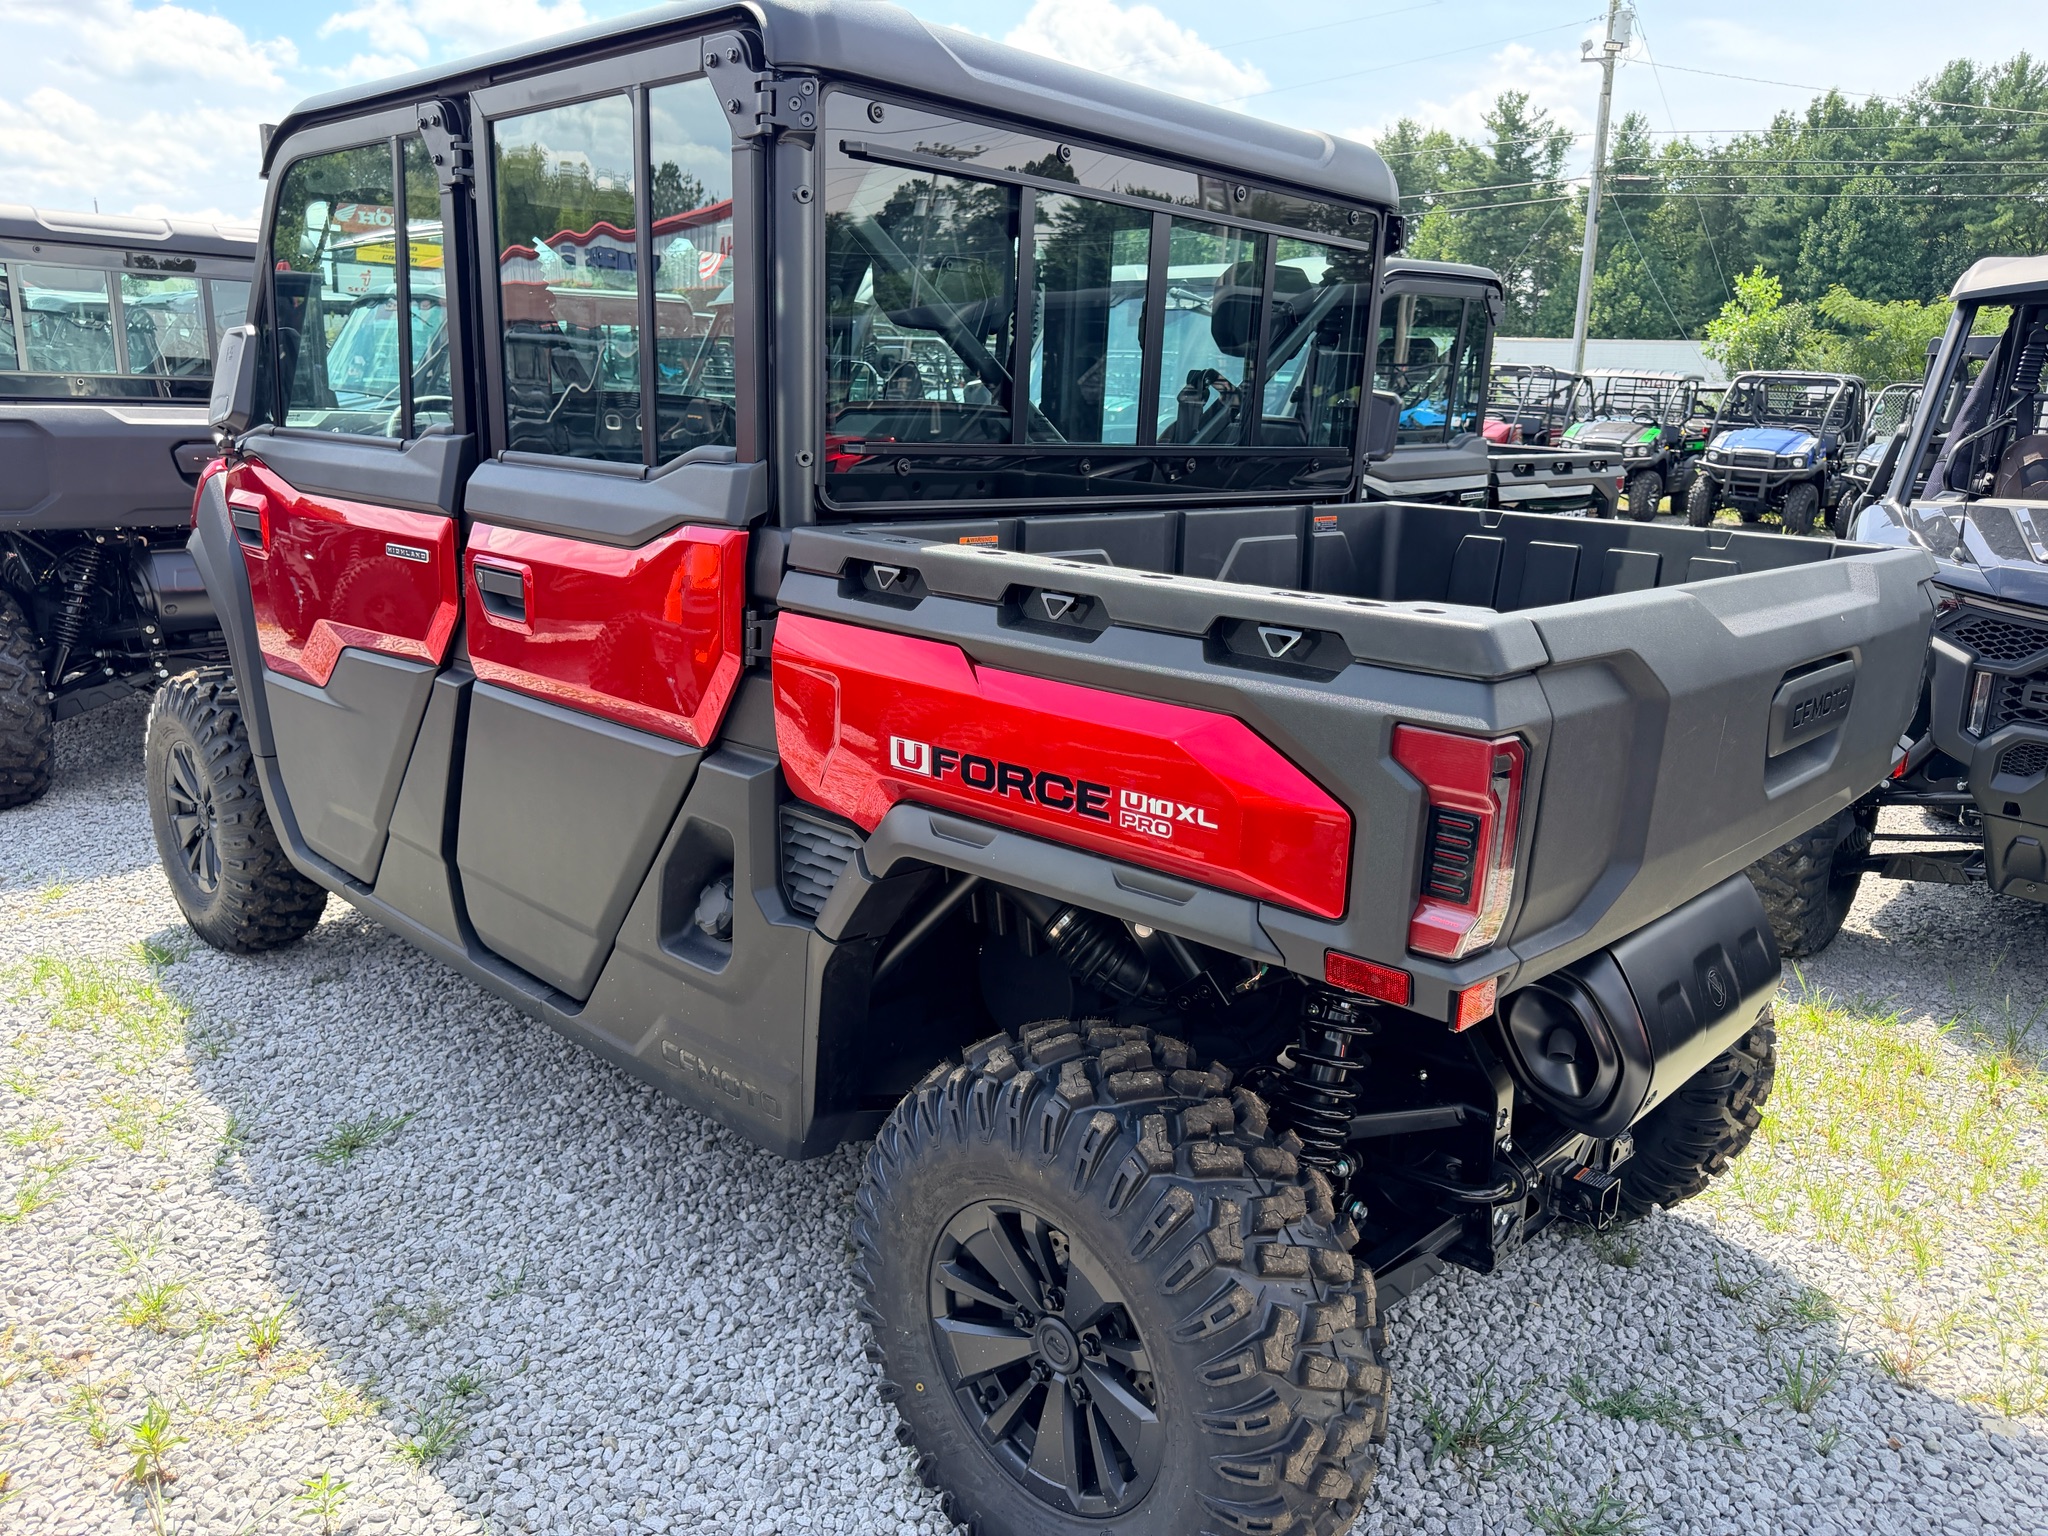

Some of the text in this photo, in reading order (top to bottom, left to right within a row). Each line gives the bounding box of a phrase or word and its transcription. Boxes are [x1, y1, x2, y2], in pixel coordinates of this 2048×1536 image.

[387, 546, 427, 560] HIGHLAND
[1792, 687, 1849, 729] CFMOTO
[1119, 809, 1173, 839] PRO
[661, 1039, 783, 1121] CFMOTO
